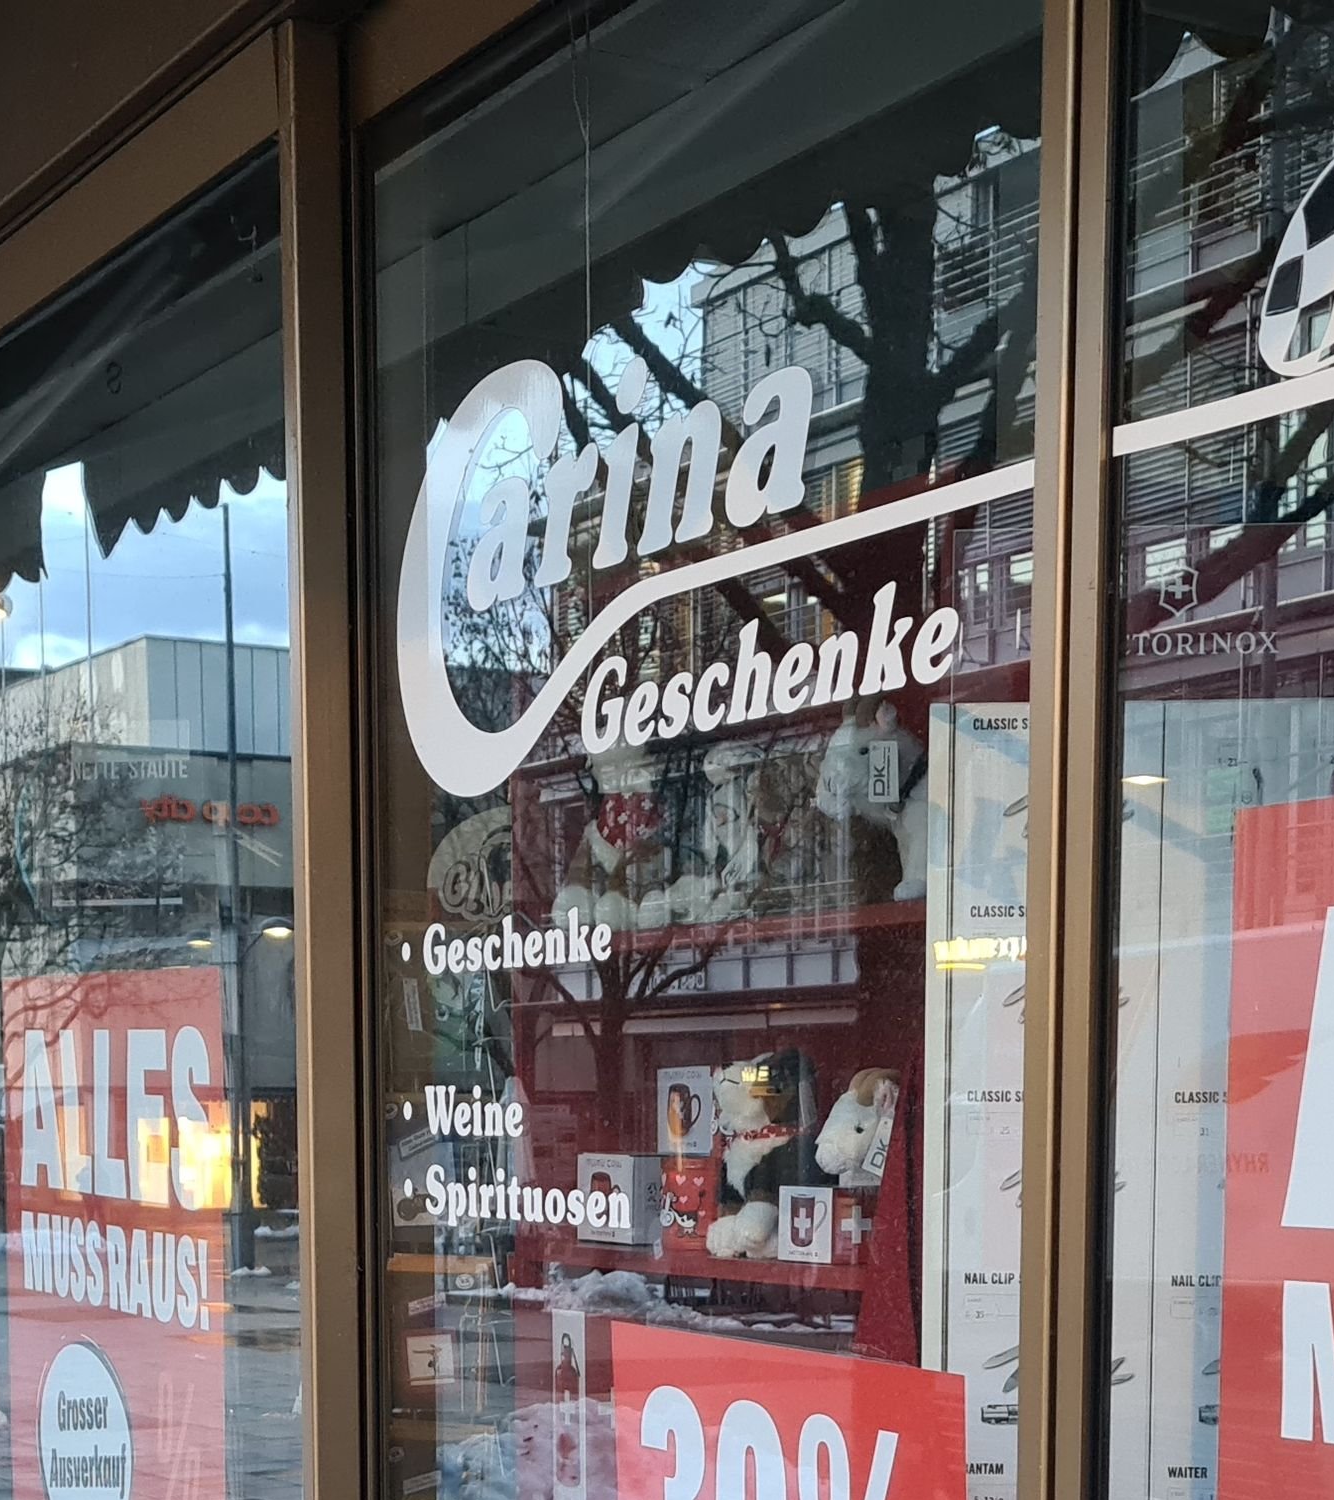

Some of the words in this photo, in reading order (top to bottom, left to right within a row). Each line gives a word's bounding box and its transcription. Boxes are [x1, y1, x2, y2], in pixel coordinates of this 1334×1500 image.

[397, 357, 813, 797] Carina
[1127, 631, 1279, 657] TORINOX
[581, 581, 960, 754] Geschenke
[973, 718, 1019, 730] CLASSIC
[873, 765, 885, 797] DK
[970, 905, 1015, 918] CLASSIC
[423, 906, 612, 976] Geschenke
[425, 1086, 523, 1138] Weine
[967, 1090, 1012, 1103] CLASSIC
[1175, 1091, 1219, 1104] CLASSIC
[21, 1025, 210, 1211] ALLES
[425, 1164, 632, 1230] Spirituosen
[21, 1211, 103, 1307] MUSS
[107, 1228, 209, 1330] RAUS!
[964, 1273, 988, 1285] NAIL
[991, 1273, 1015, 1285] CLIP
[1171, 1275, 1195, 1288] NAIL
[57, 1391, 108, 1431] Grosser
[50, 1444, 127, 1500] Ausverkauf
[1168, 1467, 1208, 1479] WAITER
